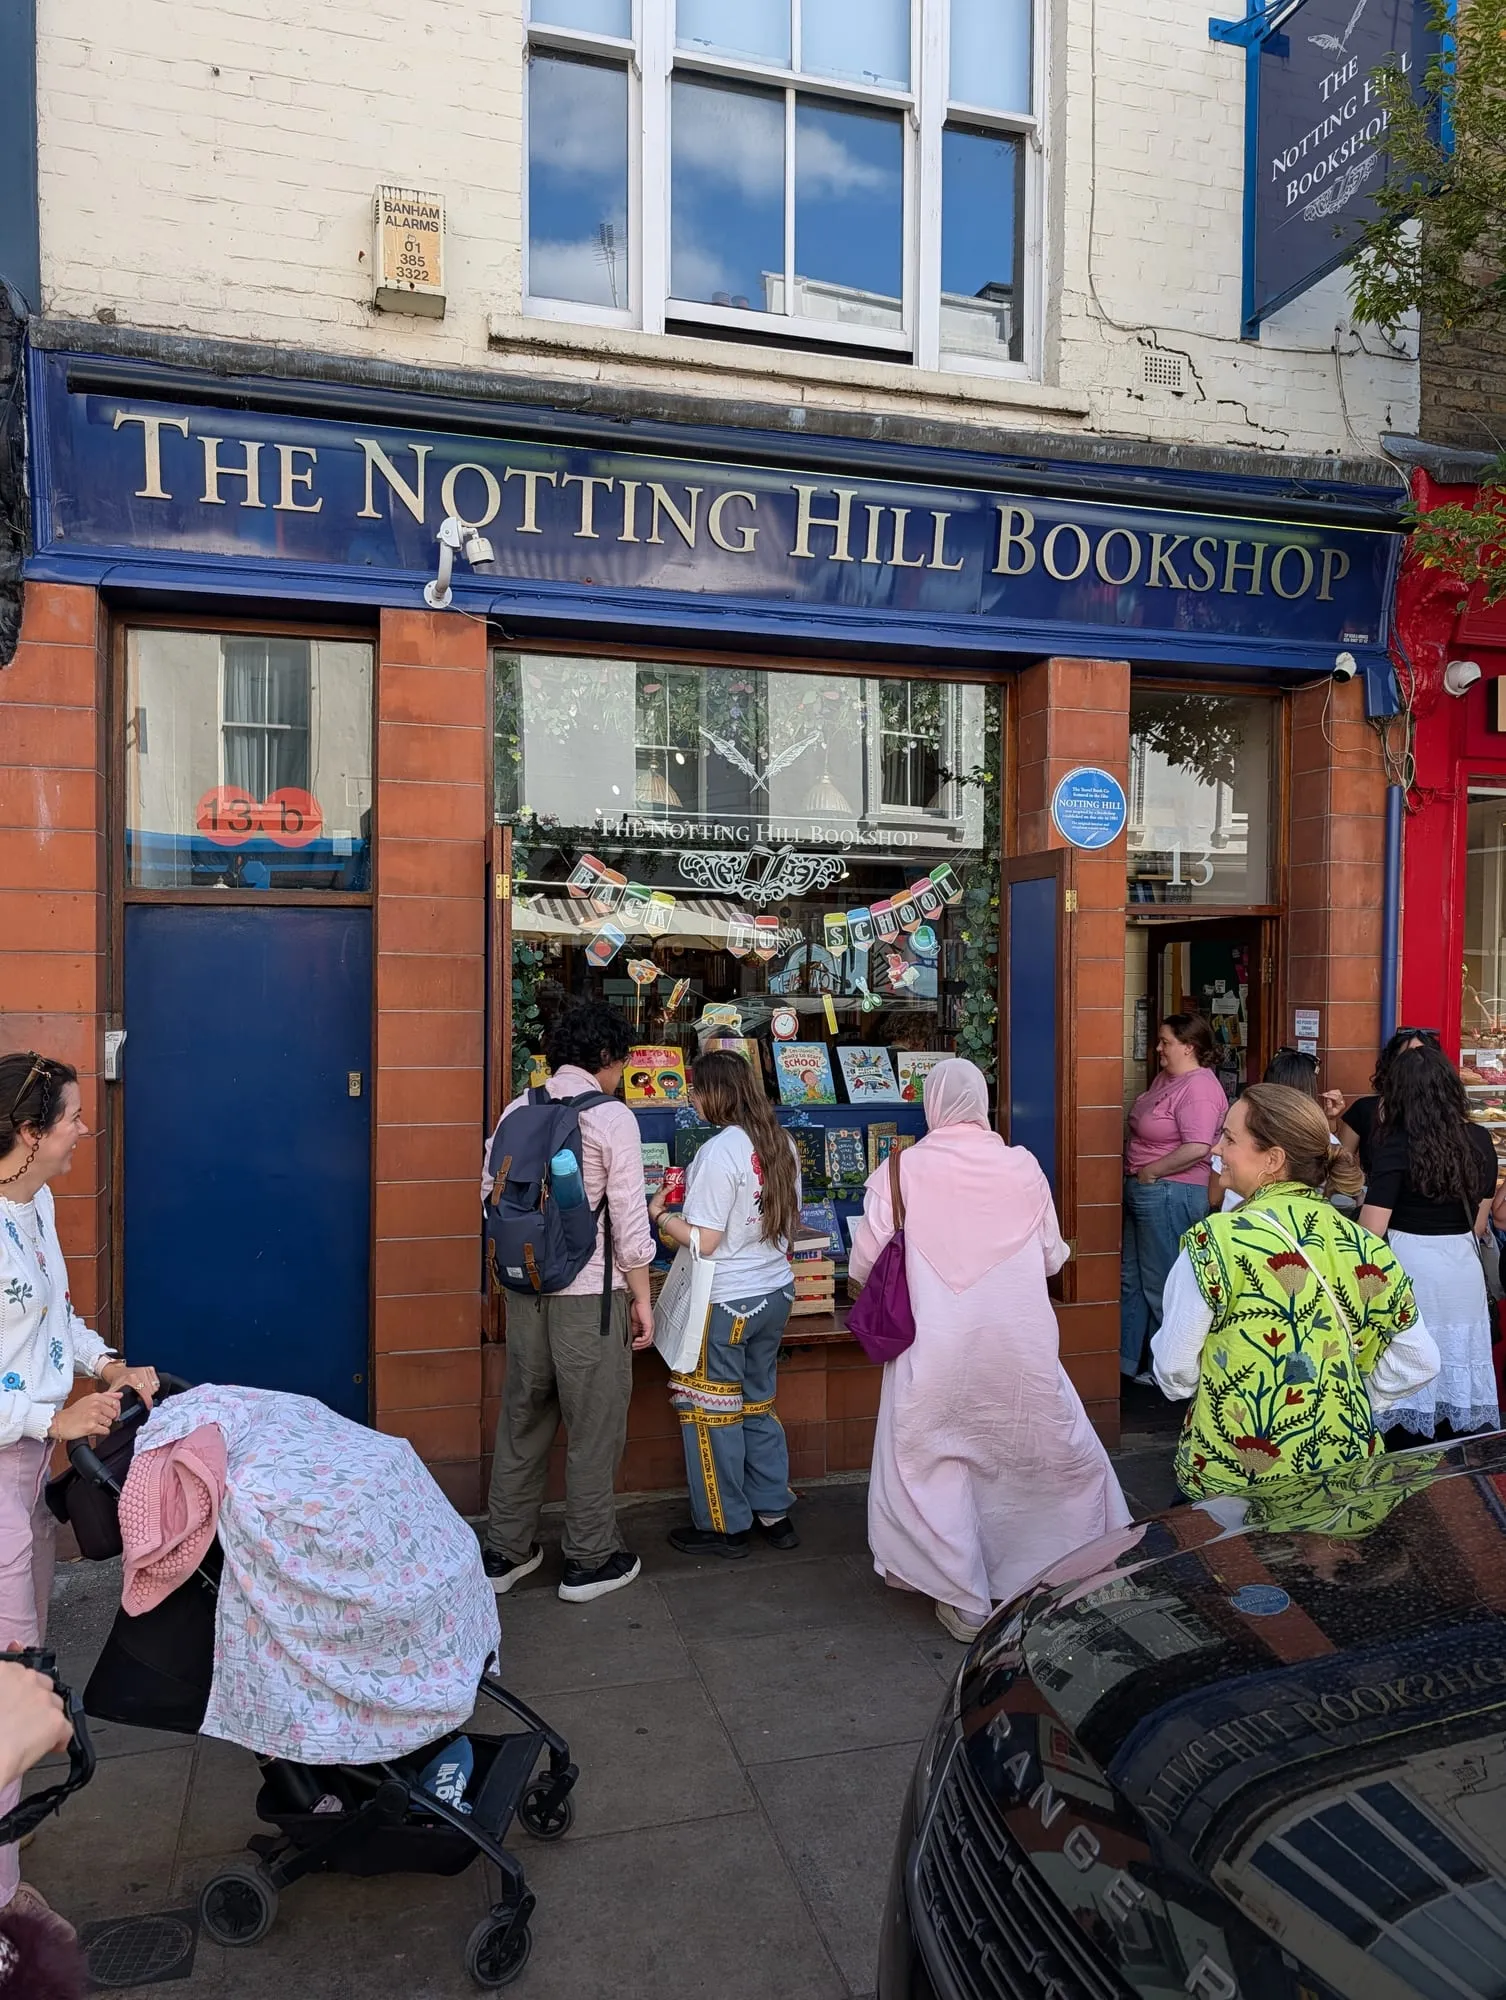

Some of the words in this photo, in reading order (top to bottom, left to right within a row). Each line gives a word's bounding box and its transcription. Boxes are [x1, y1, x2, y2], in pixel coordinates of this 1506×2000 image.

[1319, 56, 1359, 103] THE
[1271, 96, 1357, 183] NOTTING
[1363, 51, 1413, 107] HL
[384, 201, 440, 219] BANHAM
[385, 215, 439, 232] ALARMS
[405, 240, 421, 253] 01
[400, 253, 425, 267] 385
[396, 266, 429, 281] 3322
[113, 409, 323, 514] THE
[354, 437, 760, 554] NOTTING
[787, 484, 964, 571] HILL
[991, 505, 1350, 600] BOOKSHOP
[204, 798, 252, 832] 13
[1060, 799, 1100, 809] NOTTING
[1102, 802, 1122, 810] HILL
[598, 817, 643, 837] THE
[650, 822, 749, 842] NOTTING
[756, 823, 804, 843] HILL
[811, 826, 919, 846] BOOKSHOP
[1166, 840, 1214, 886] 13
[572, 866, 666, 928] BACK
[829, 878, 958, 946] SCHOOL
[784, 1058, 820, 1068] SCHOOL
